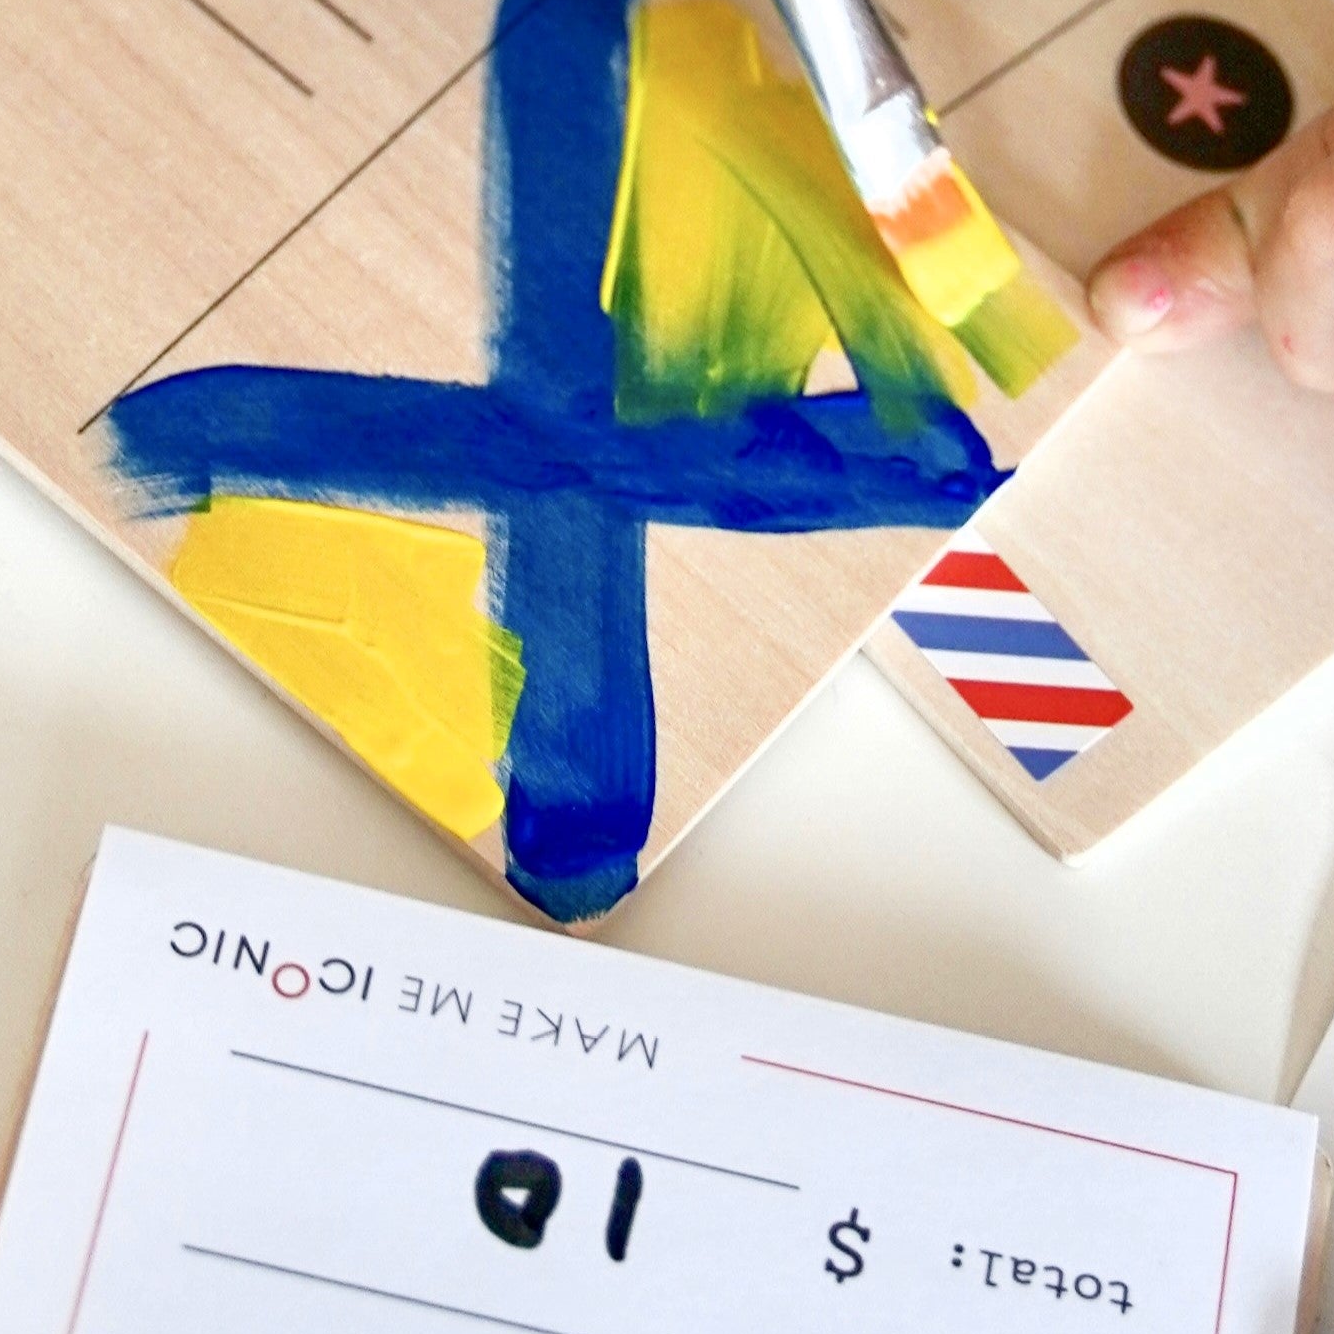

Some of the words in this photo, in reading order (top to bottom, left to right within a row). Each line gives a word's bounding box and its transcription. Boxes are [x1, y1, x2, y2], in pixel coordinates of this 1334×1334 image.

[169, 921, 374, 1001] ICONIC
[398, 975, 473, 1024] ME
[498, 999, 659, 1069] MAKE
[474, 1148, 643, 1263] 10
[825, 1208, 871, 1284] $
[951, 1243, 1134, 1314] total:
